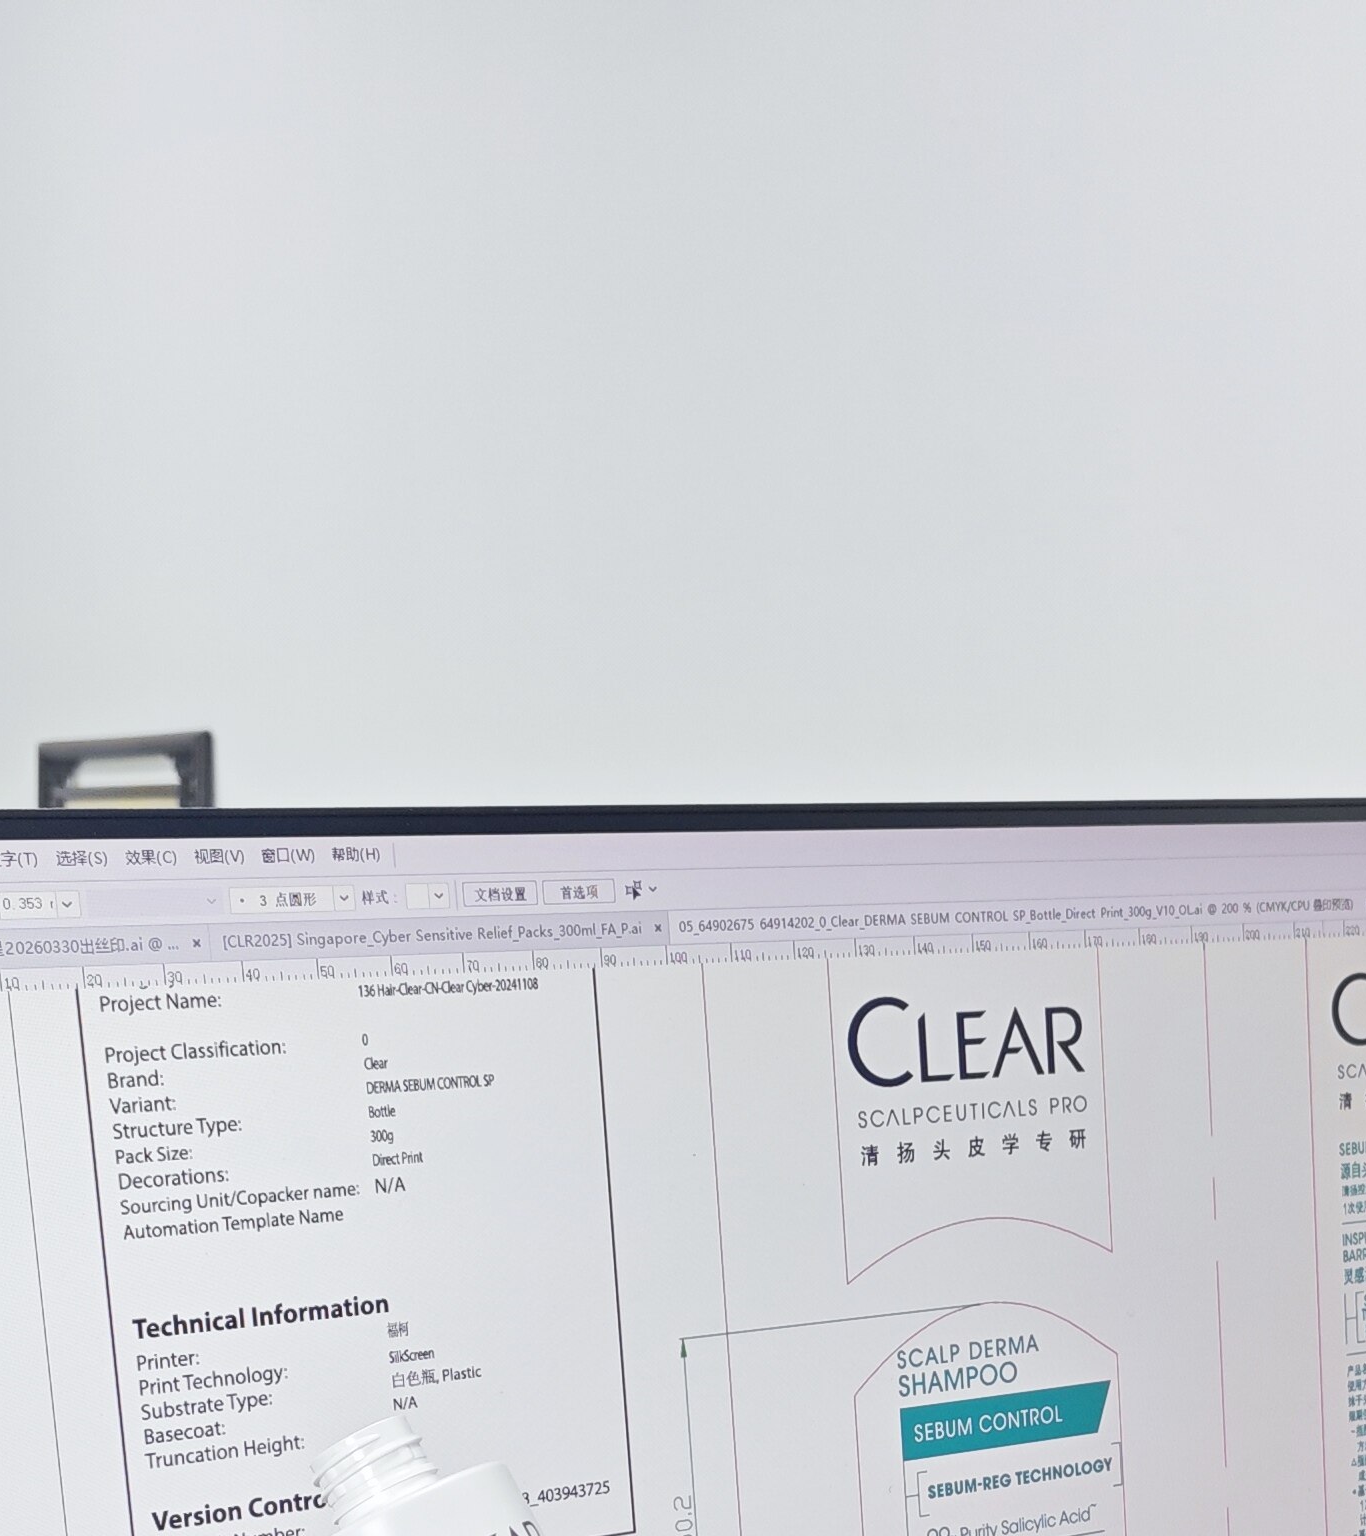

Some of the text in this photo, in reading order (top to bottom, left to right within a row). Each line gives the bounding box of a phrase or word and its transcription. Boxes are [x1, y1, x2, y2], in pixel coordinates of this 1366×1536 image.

[56, 850, 108, 867] 选择(S)
[125, 849, 177, 866] 效果(C)
[194, 848, 245, 865] 视图(V)
[261, 847, 316, 865] 窗口(W)
[332, 846, 381, 864] 帮助(H)
[474, 886, 528, 903] 文档设置
[560, 885, 599, 901] 首选项
[910, 911, 950, 925] SEBUM
[954, 909, 1009, 924] CONTROL
[222, 932, 292, 951] [CLR2025]
[296, 928, 411, 950] Singapore_Cyber
[416, 926, 473, 943] Sensitive
[99, 992, 223, 1016] Project Name:
[105, 1038, 287, 1066] Project Classification:
[847, 996, 1086, 1088] CLEAR
[364, 1056, 388, 1070] Clear
[107, 1069, 165, 1089] Brand:
[366, 1075, 482, 1095] DERMA SEBUM CONTROL
[109, 1096, 176, 1115] Variant:
[368, 1104, 396, 1119] Bottle
[857, 1094, 1088, 1129] SCALPCEUTICALS PRO
[112, 1117, 242, 1140] Structure Type:
[370, 1129, 394, 1145] 300g
[115, 1146, 193, 1165] Pack Size:
[372, 1150, 424, 1167] Direct Print
[860, 1128, 1087, 1167] 清扬头皮学专研
[118, 1168, 230, 1190] Decorations:
[375, 1176, 407, 1195] N/A
[120, 1183, 361, 1215] Sourcing Unit/Copacker name:
[123, 1208, 344, 1240] Automation Template Name
[132, 1295, 390, 1340] Technical Information
[136, 1352, 200, 1372] Printer:
[389, 1349, 436, 1364] SilkScreen
[897, 1334, 1039, 1370] SCALP DERMA
[138, 1365, 289, 1396] Print Technology:
[441, 1365, 483, 1382] Plastic
[898, 1361, 1018, 1398] SHAMPOO
[140, 1391, 274, 1421] Substrate Type:
[143, 1421, 227, 1446] Basecoat:
[913, 1404, 1063, 1443] SEBUM CONTROL
[144, 1434, 306, 1470] Truncation Height:
[927, 1456, 1113, 1500] SEBUM-REG TECHNOLOGY
[151, 1503, 243, 1532] Version
[1001, 1512, 1057, 1536] Salicylic
